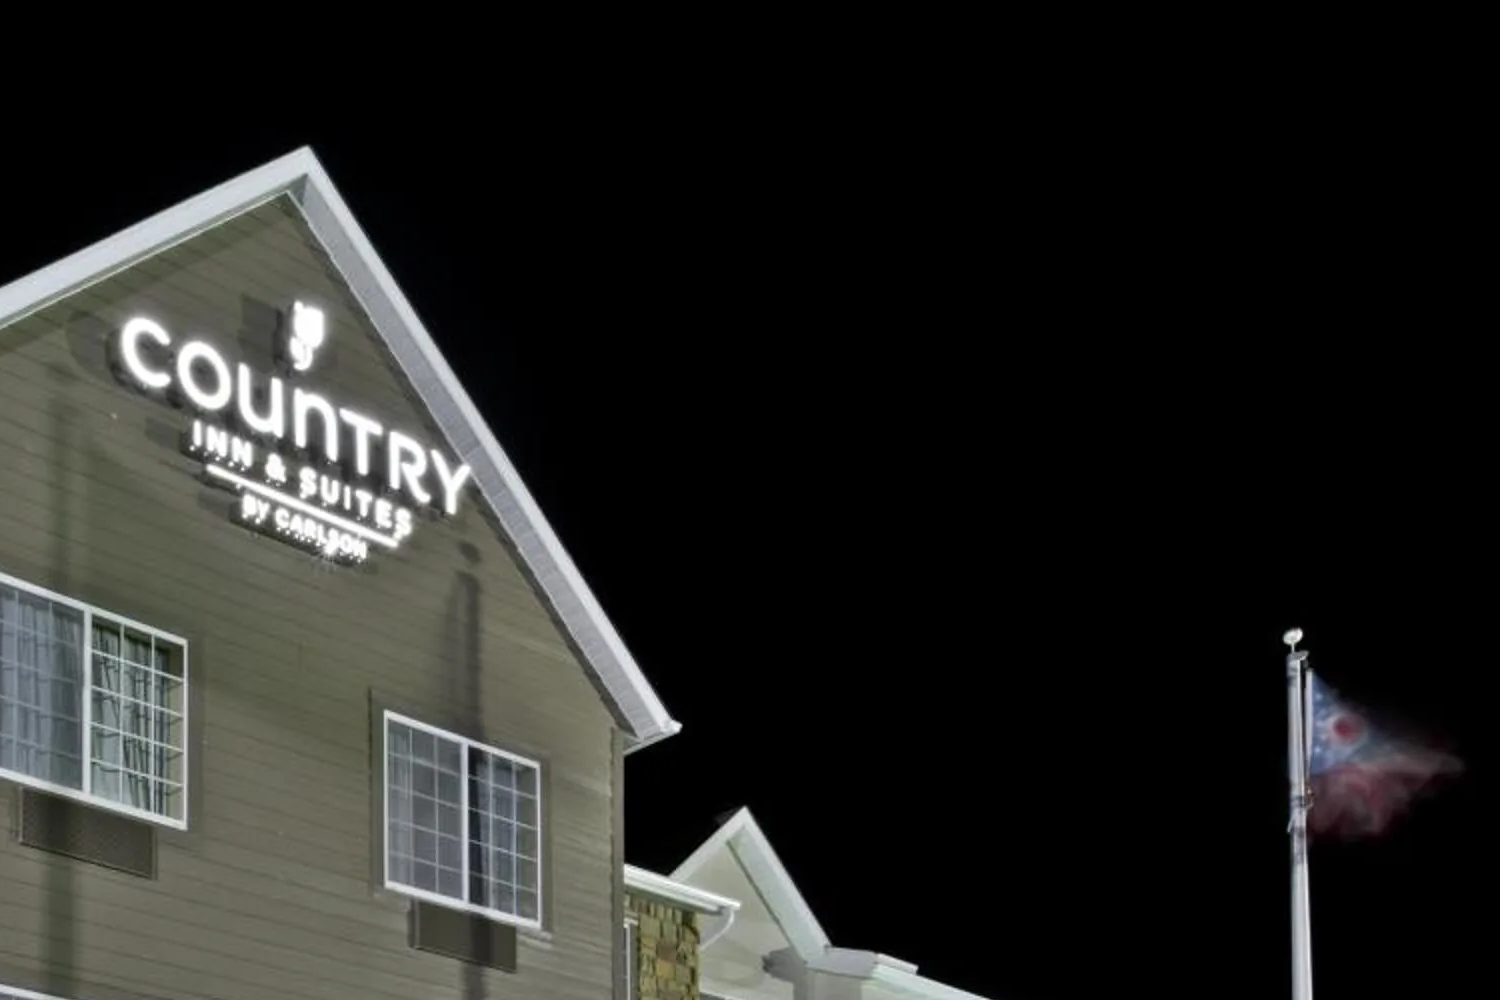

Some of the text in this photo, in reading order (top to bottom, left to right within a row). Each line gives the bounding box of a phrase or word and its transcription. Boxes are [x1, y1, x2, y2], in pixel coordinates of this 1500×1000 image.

[192, 419, 412, 539] INN & SUITES
